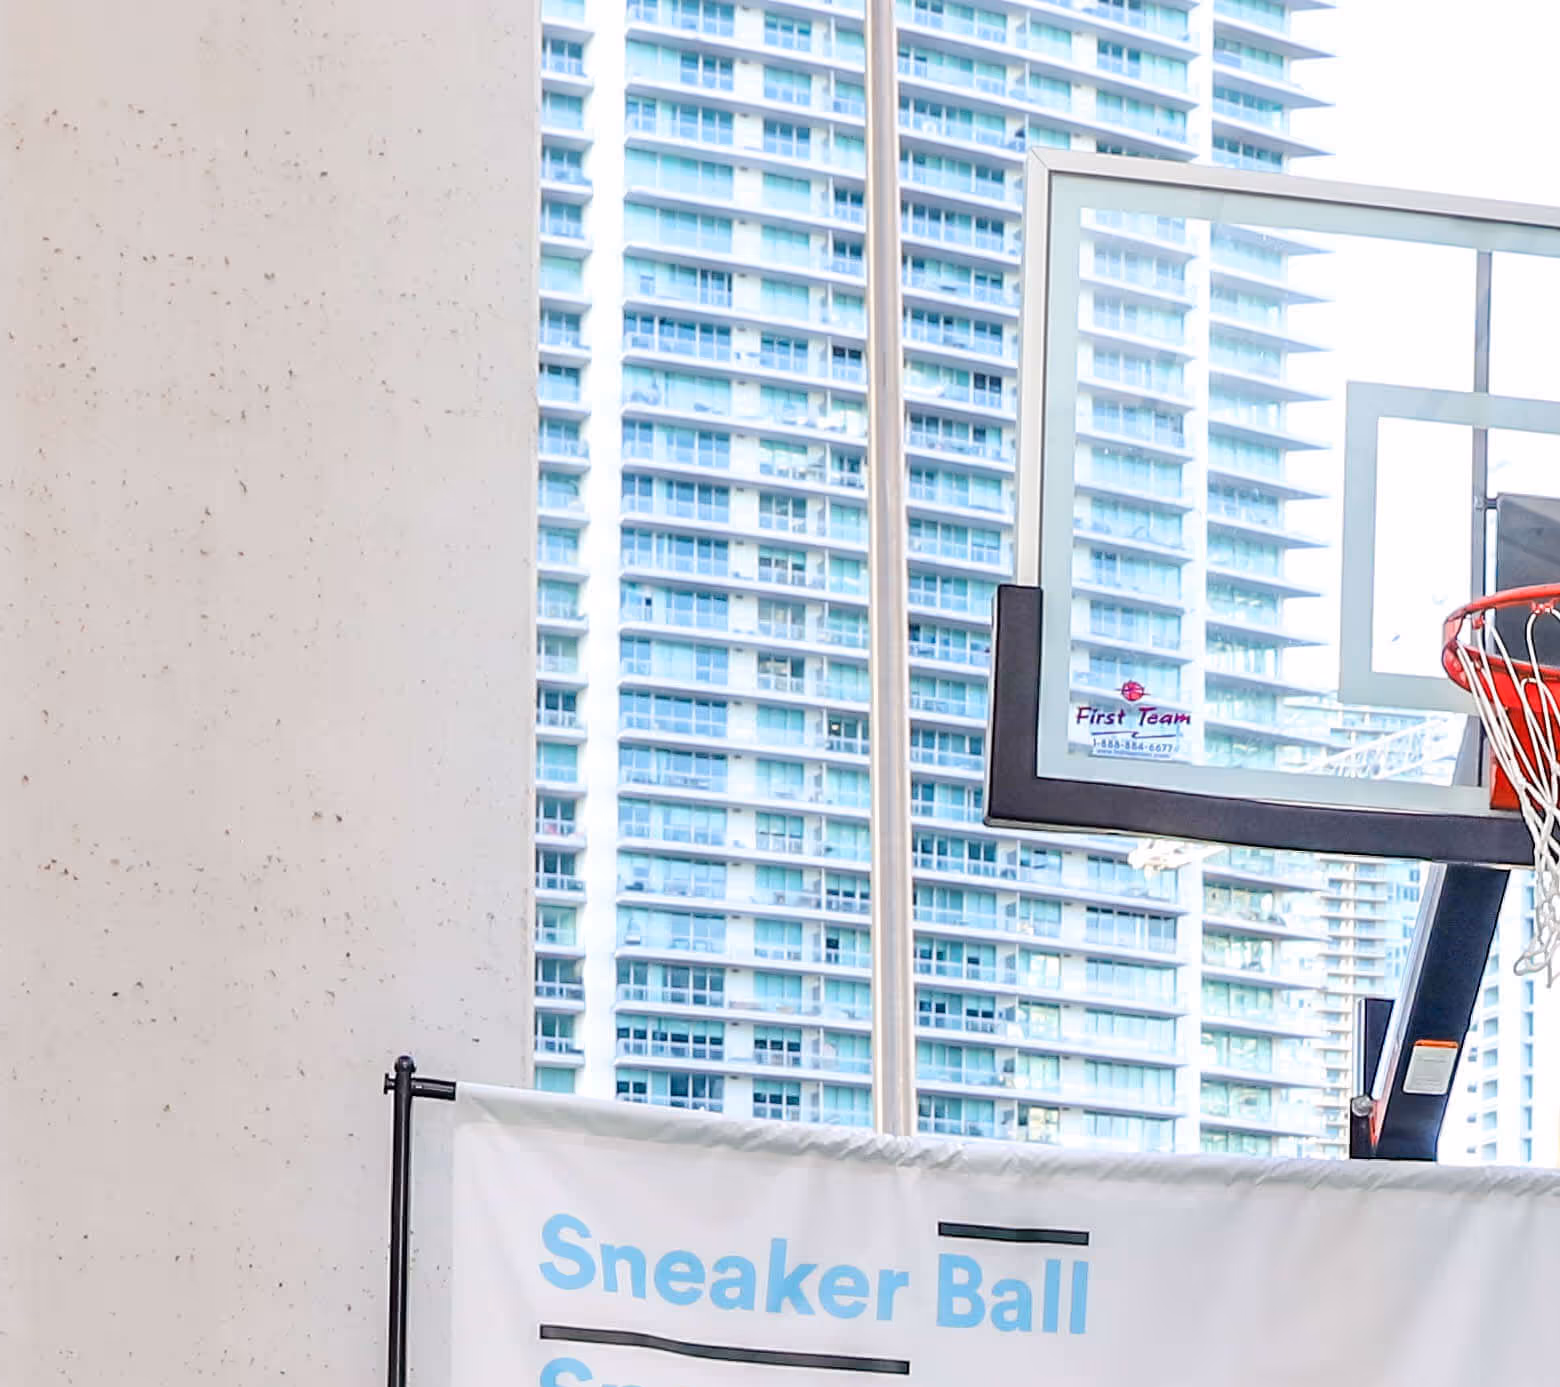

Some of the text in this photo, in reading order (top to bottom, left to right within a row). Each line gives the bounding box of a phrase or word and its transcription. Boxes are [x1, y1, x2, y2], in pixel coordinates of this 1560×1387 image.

[1076, 706, 1191, 727] First Team
[540, 1214, 1088, 1334] Sneaker Ball
